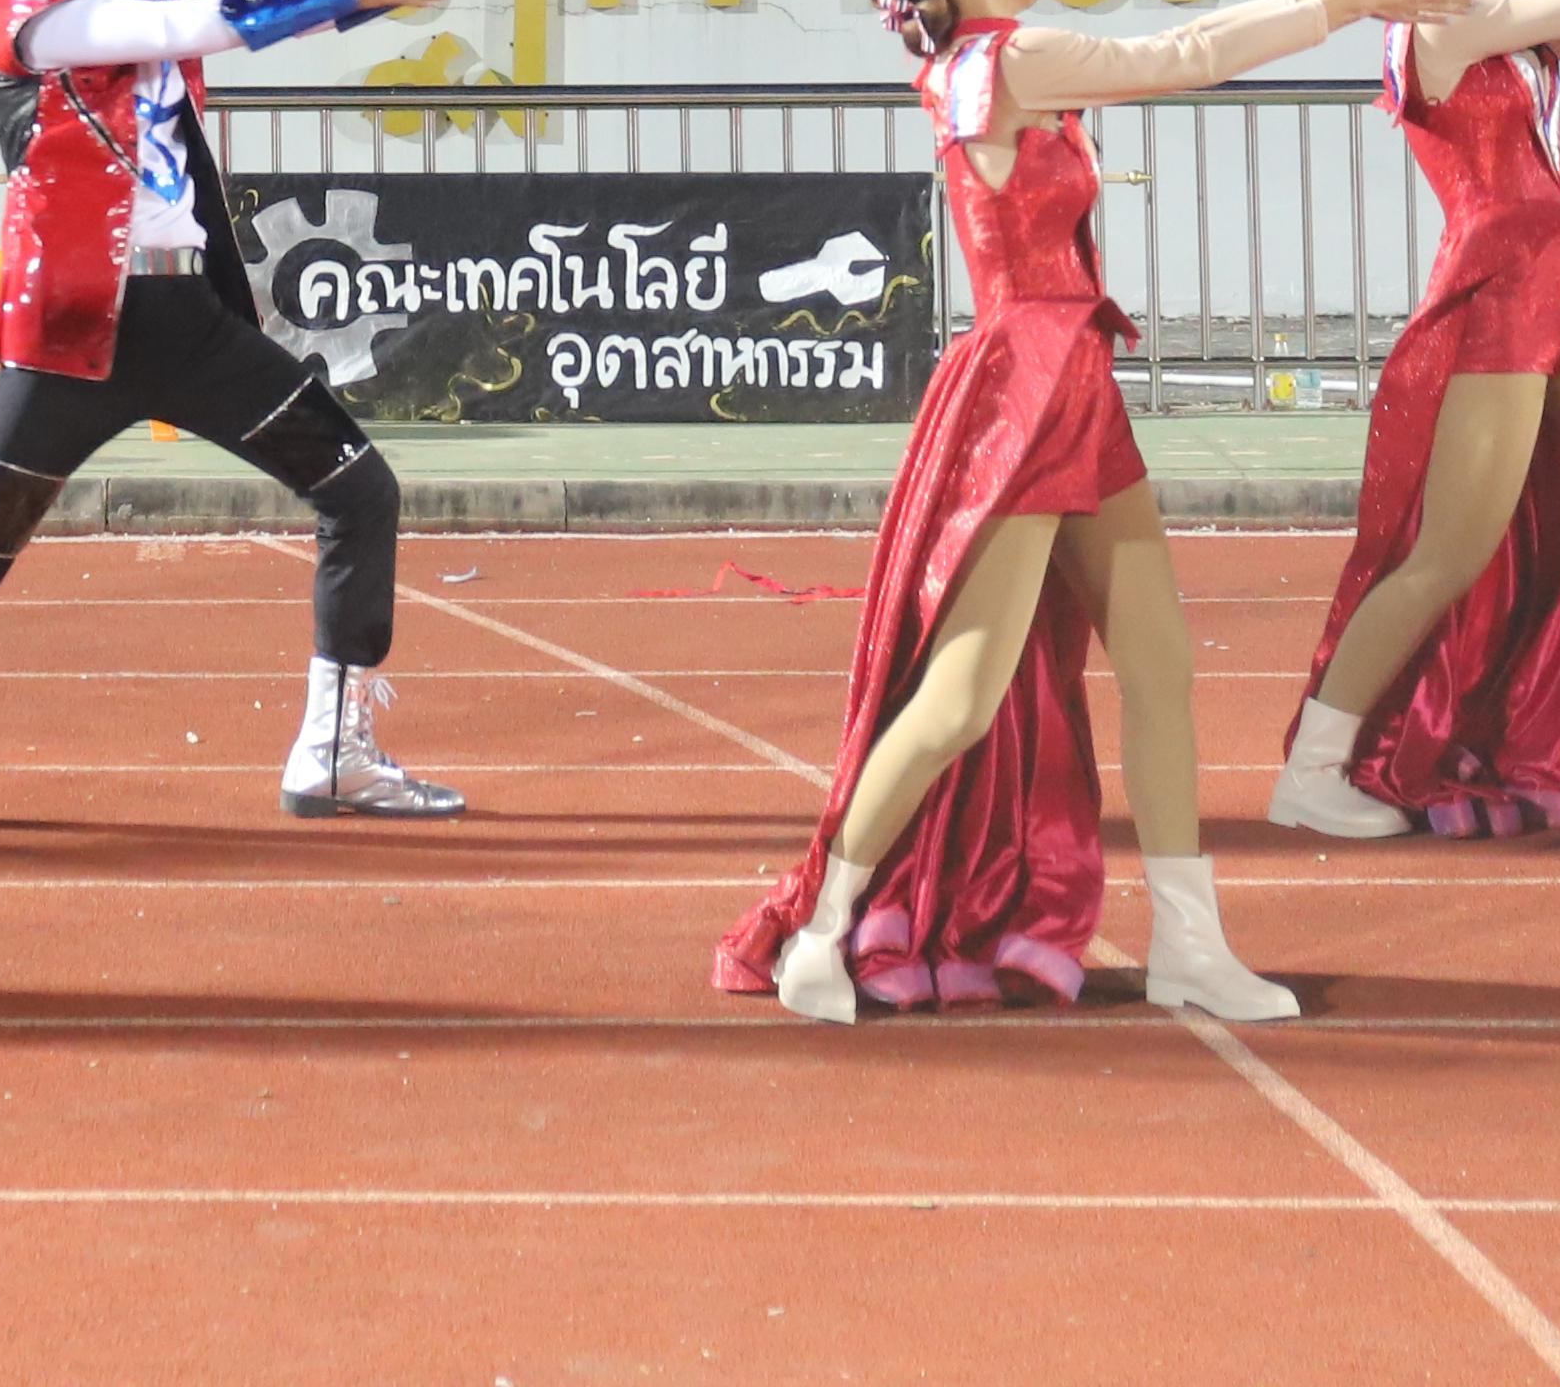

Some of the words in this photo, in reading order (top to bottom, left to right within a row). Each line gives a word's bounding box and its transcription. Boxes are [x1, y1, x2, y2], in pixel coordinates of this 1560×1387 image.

[298, 220, 729, 323] คณะเทคโนโลยี
[544, 326, 884, 409] อุตสาหกรรม
